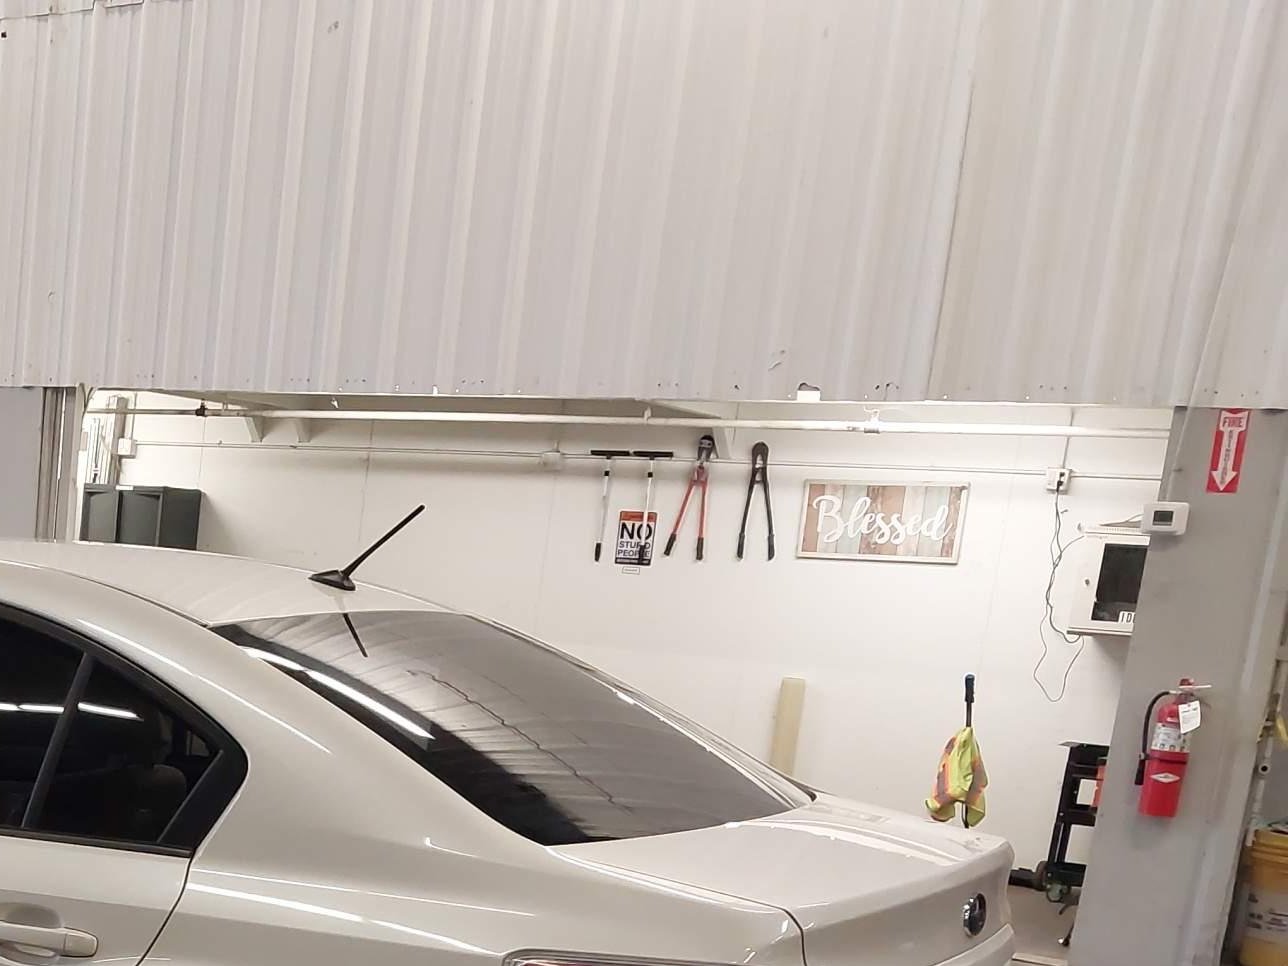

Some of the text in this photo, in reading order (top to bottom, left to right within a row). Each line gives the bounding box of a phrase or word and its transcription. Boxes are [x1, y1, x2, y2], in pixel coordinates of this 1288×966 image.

[813, 494, 953, 545] Blessed
[620, 522, 652, 540] NO
[619, 541, 650, 549] STUPD
